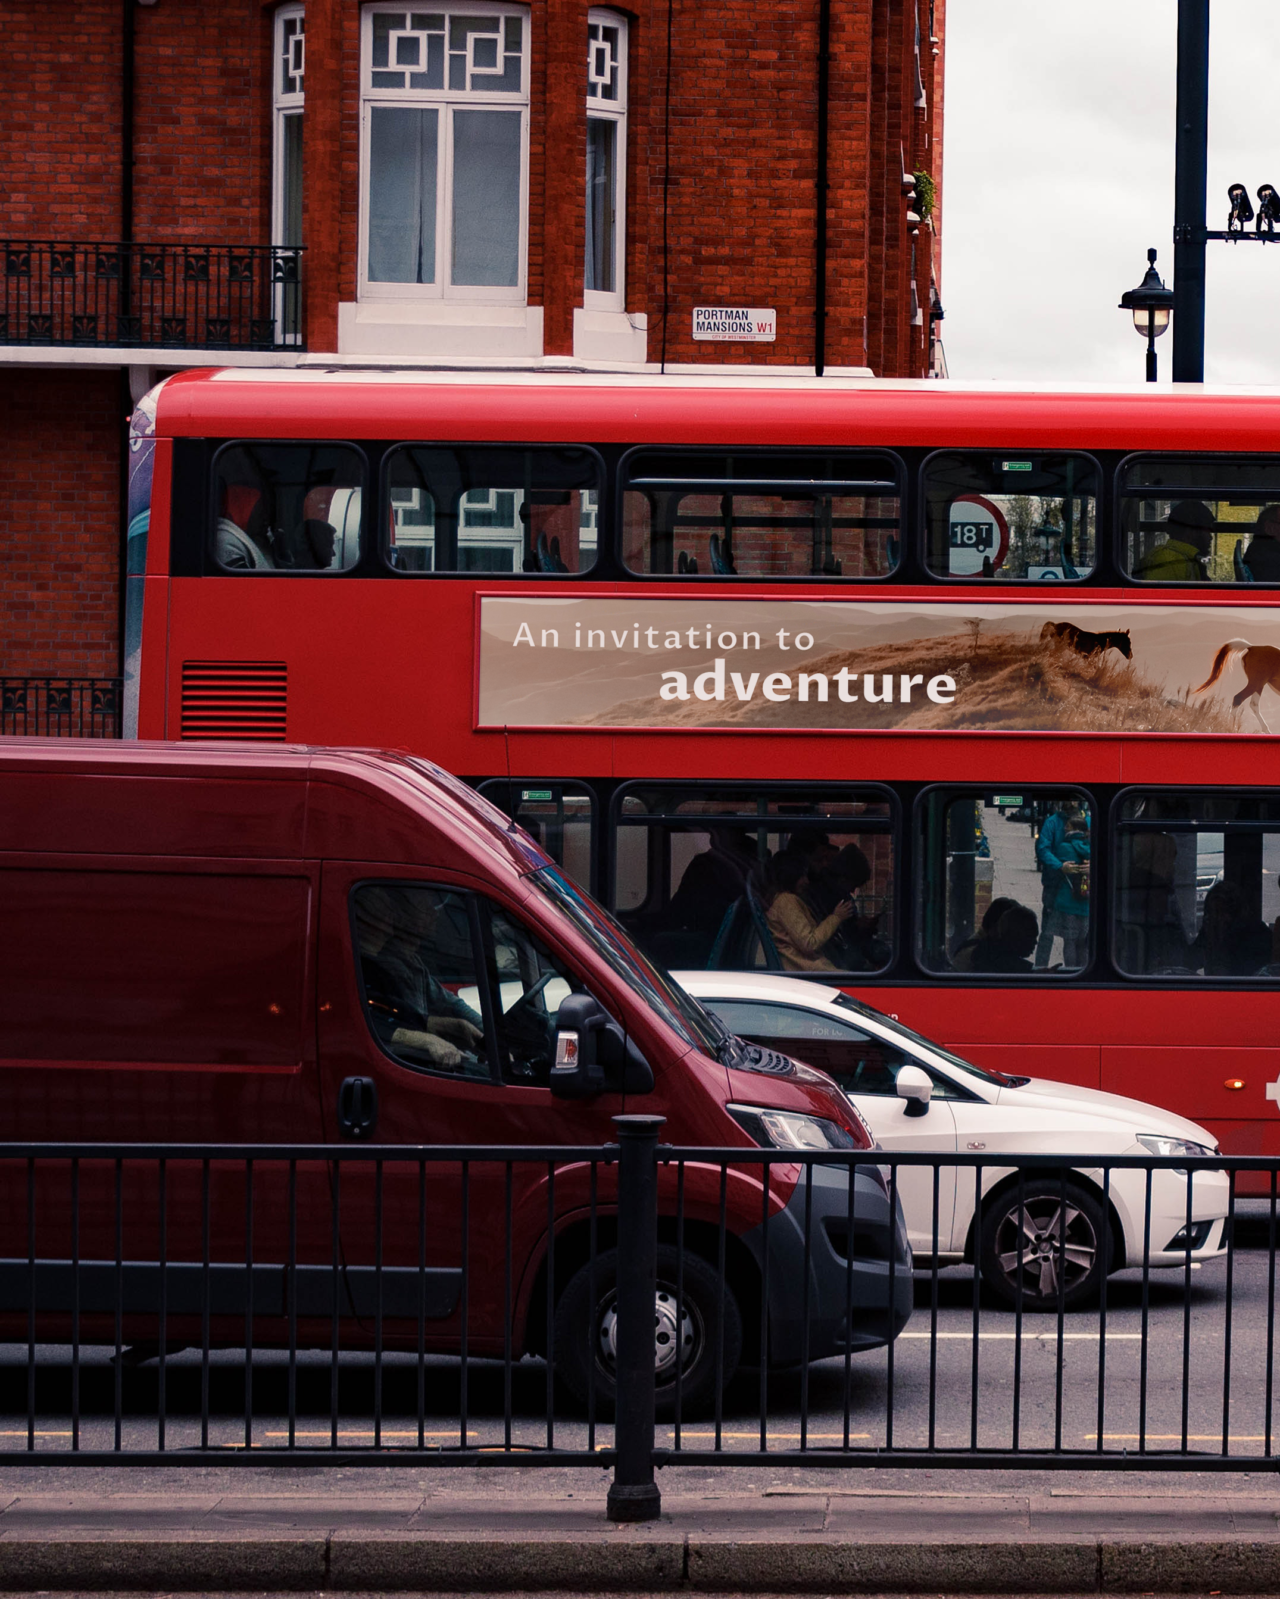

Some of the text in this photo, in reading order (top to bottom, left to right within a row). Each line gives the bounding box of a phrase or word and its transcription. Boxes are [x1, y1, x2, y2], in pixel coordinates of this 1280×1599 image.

[696, 309, 749, 320] PORTMAN
[696, 321, 773, 332] MANSIONS W1
[954, 525, 989, 544] 18 T
[513, 622, 816, 651] An invitation to
[659, 658, 957, 704] adventure
